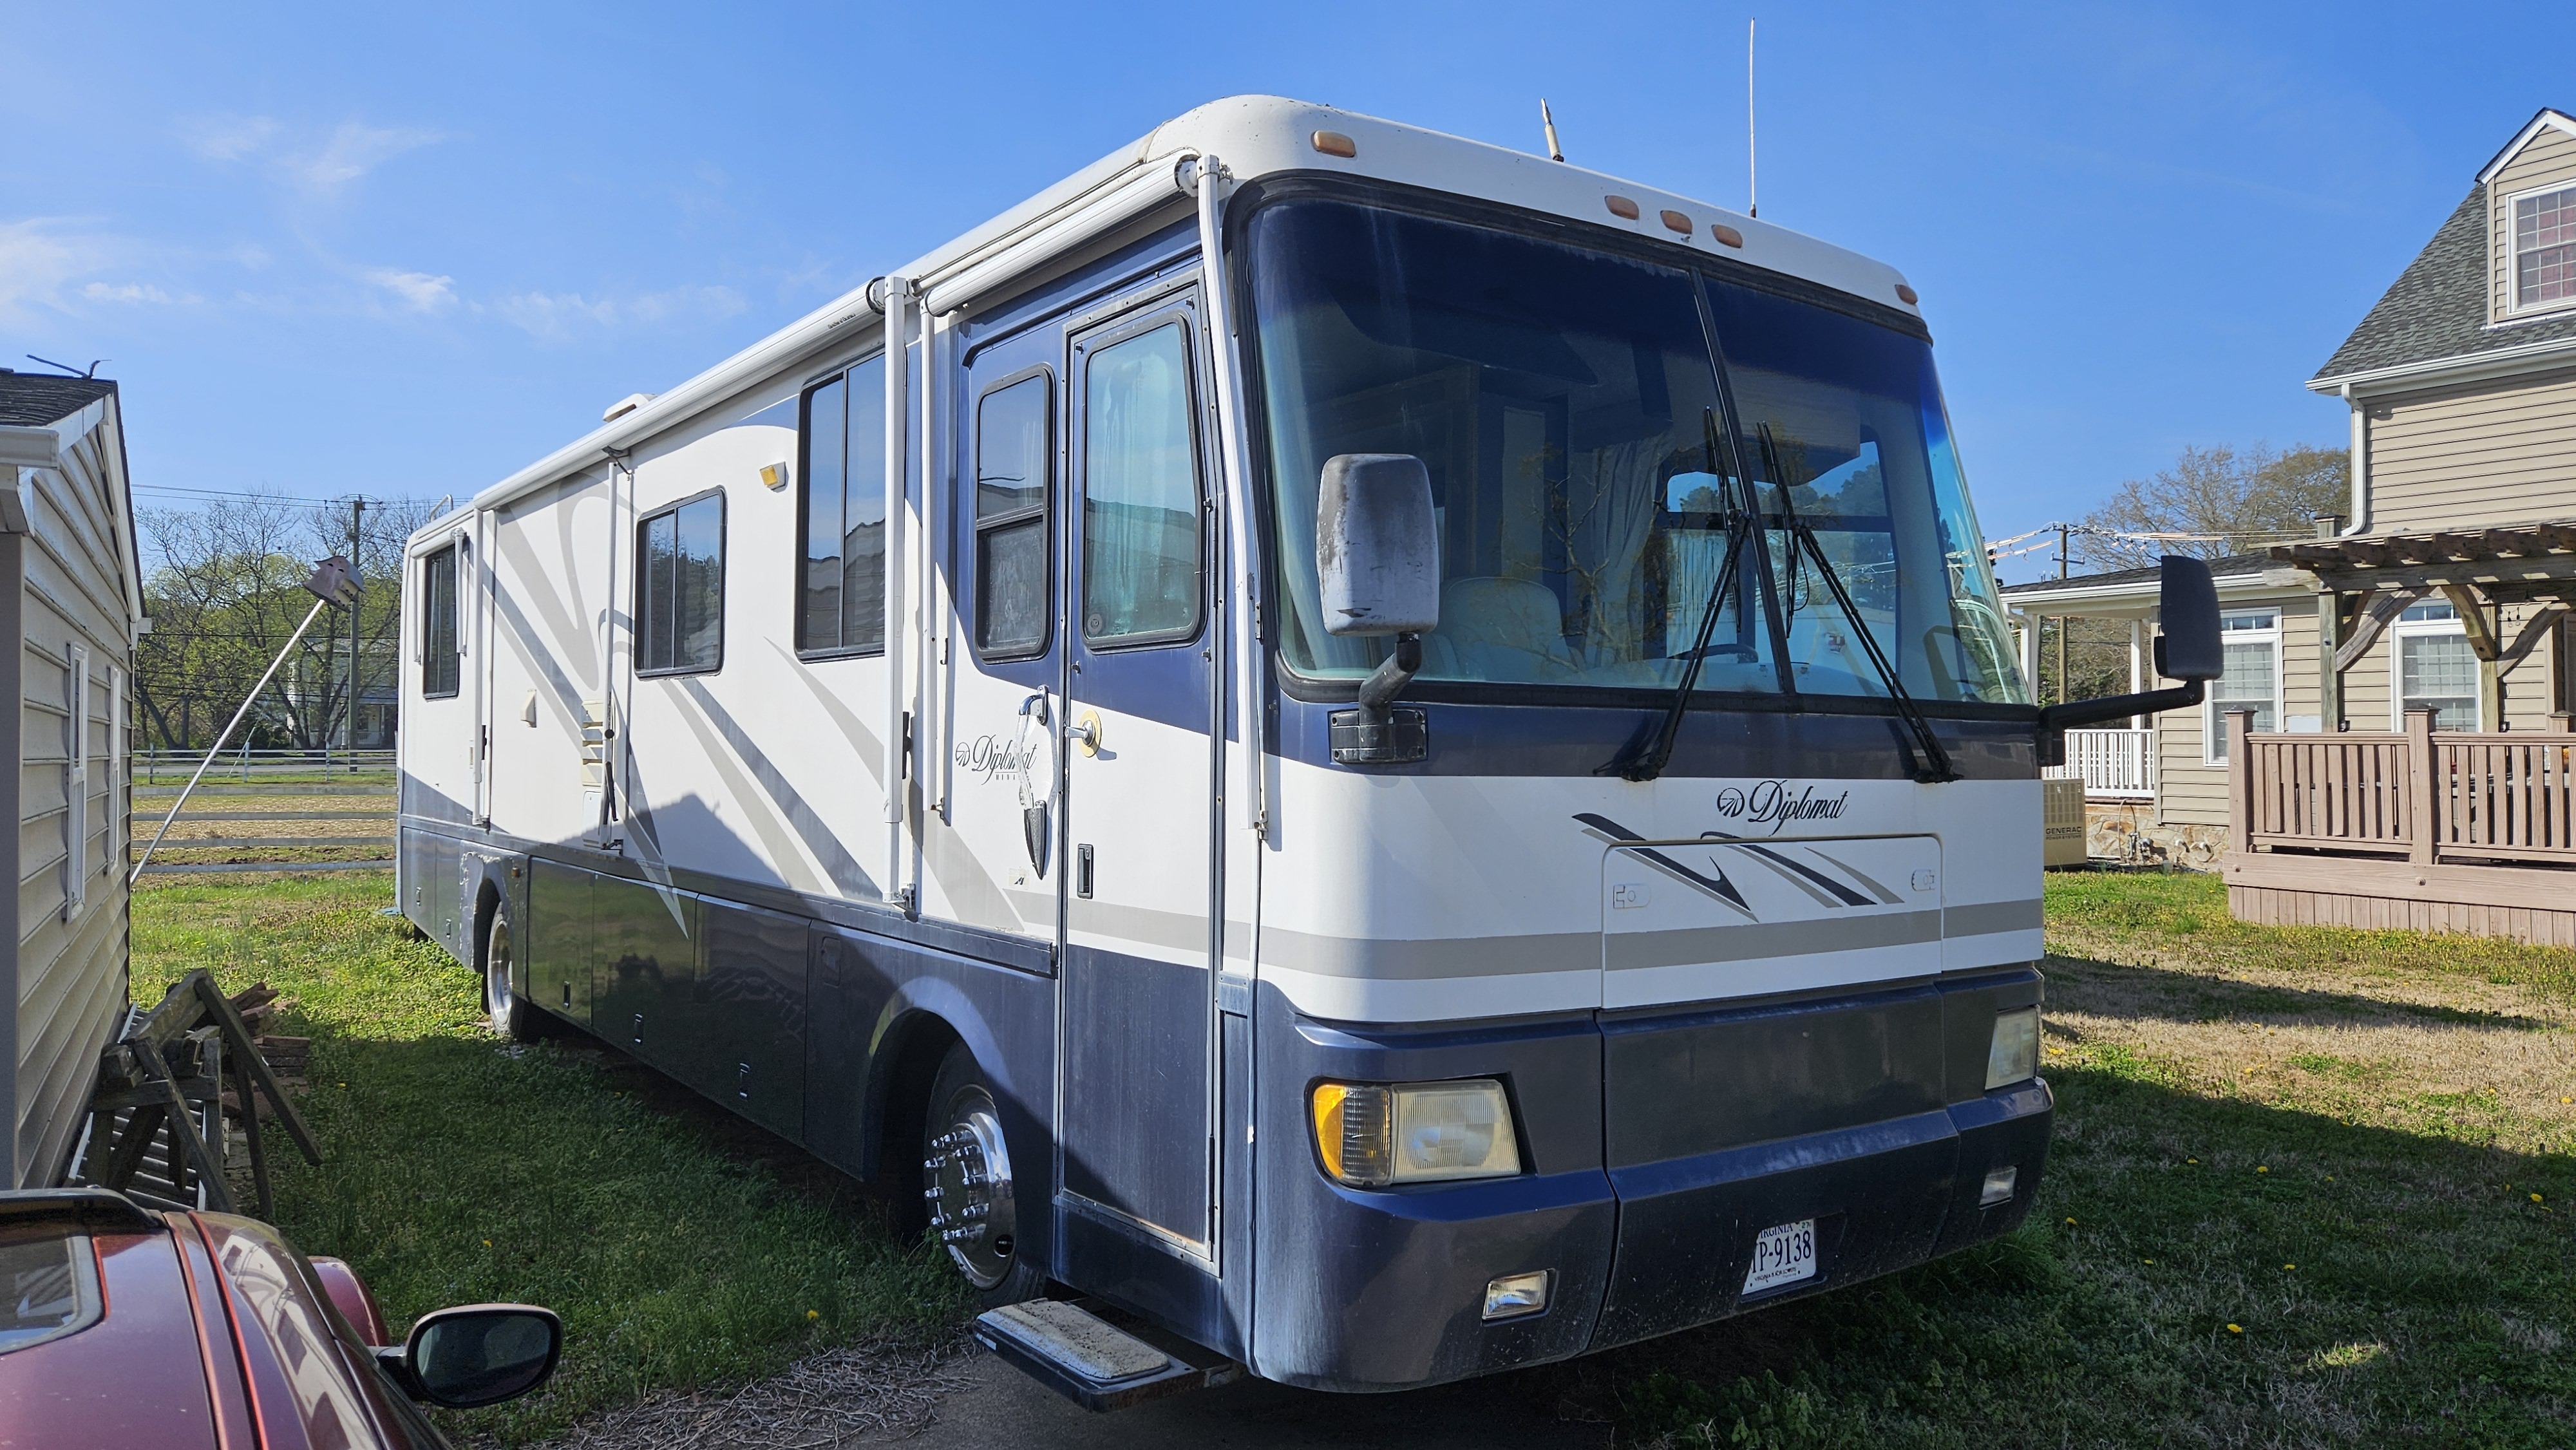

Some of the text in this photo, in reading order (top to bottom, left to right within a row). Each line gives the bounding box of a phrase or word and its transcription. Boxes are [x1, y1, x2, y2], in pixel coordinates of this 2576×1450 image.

[971, 734, 1037, 786] Diplomat
[1747, 779, 1848, 837] Diplomat
[2045, 826, 2082, 834] GENERAC
[1760, 1223, 1794, 1239] IRGINIA
